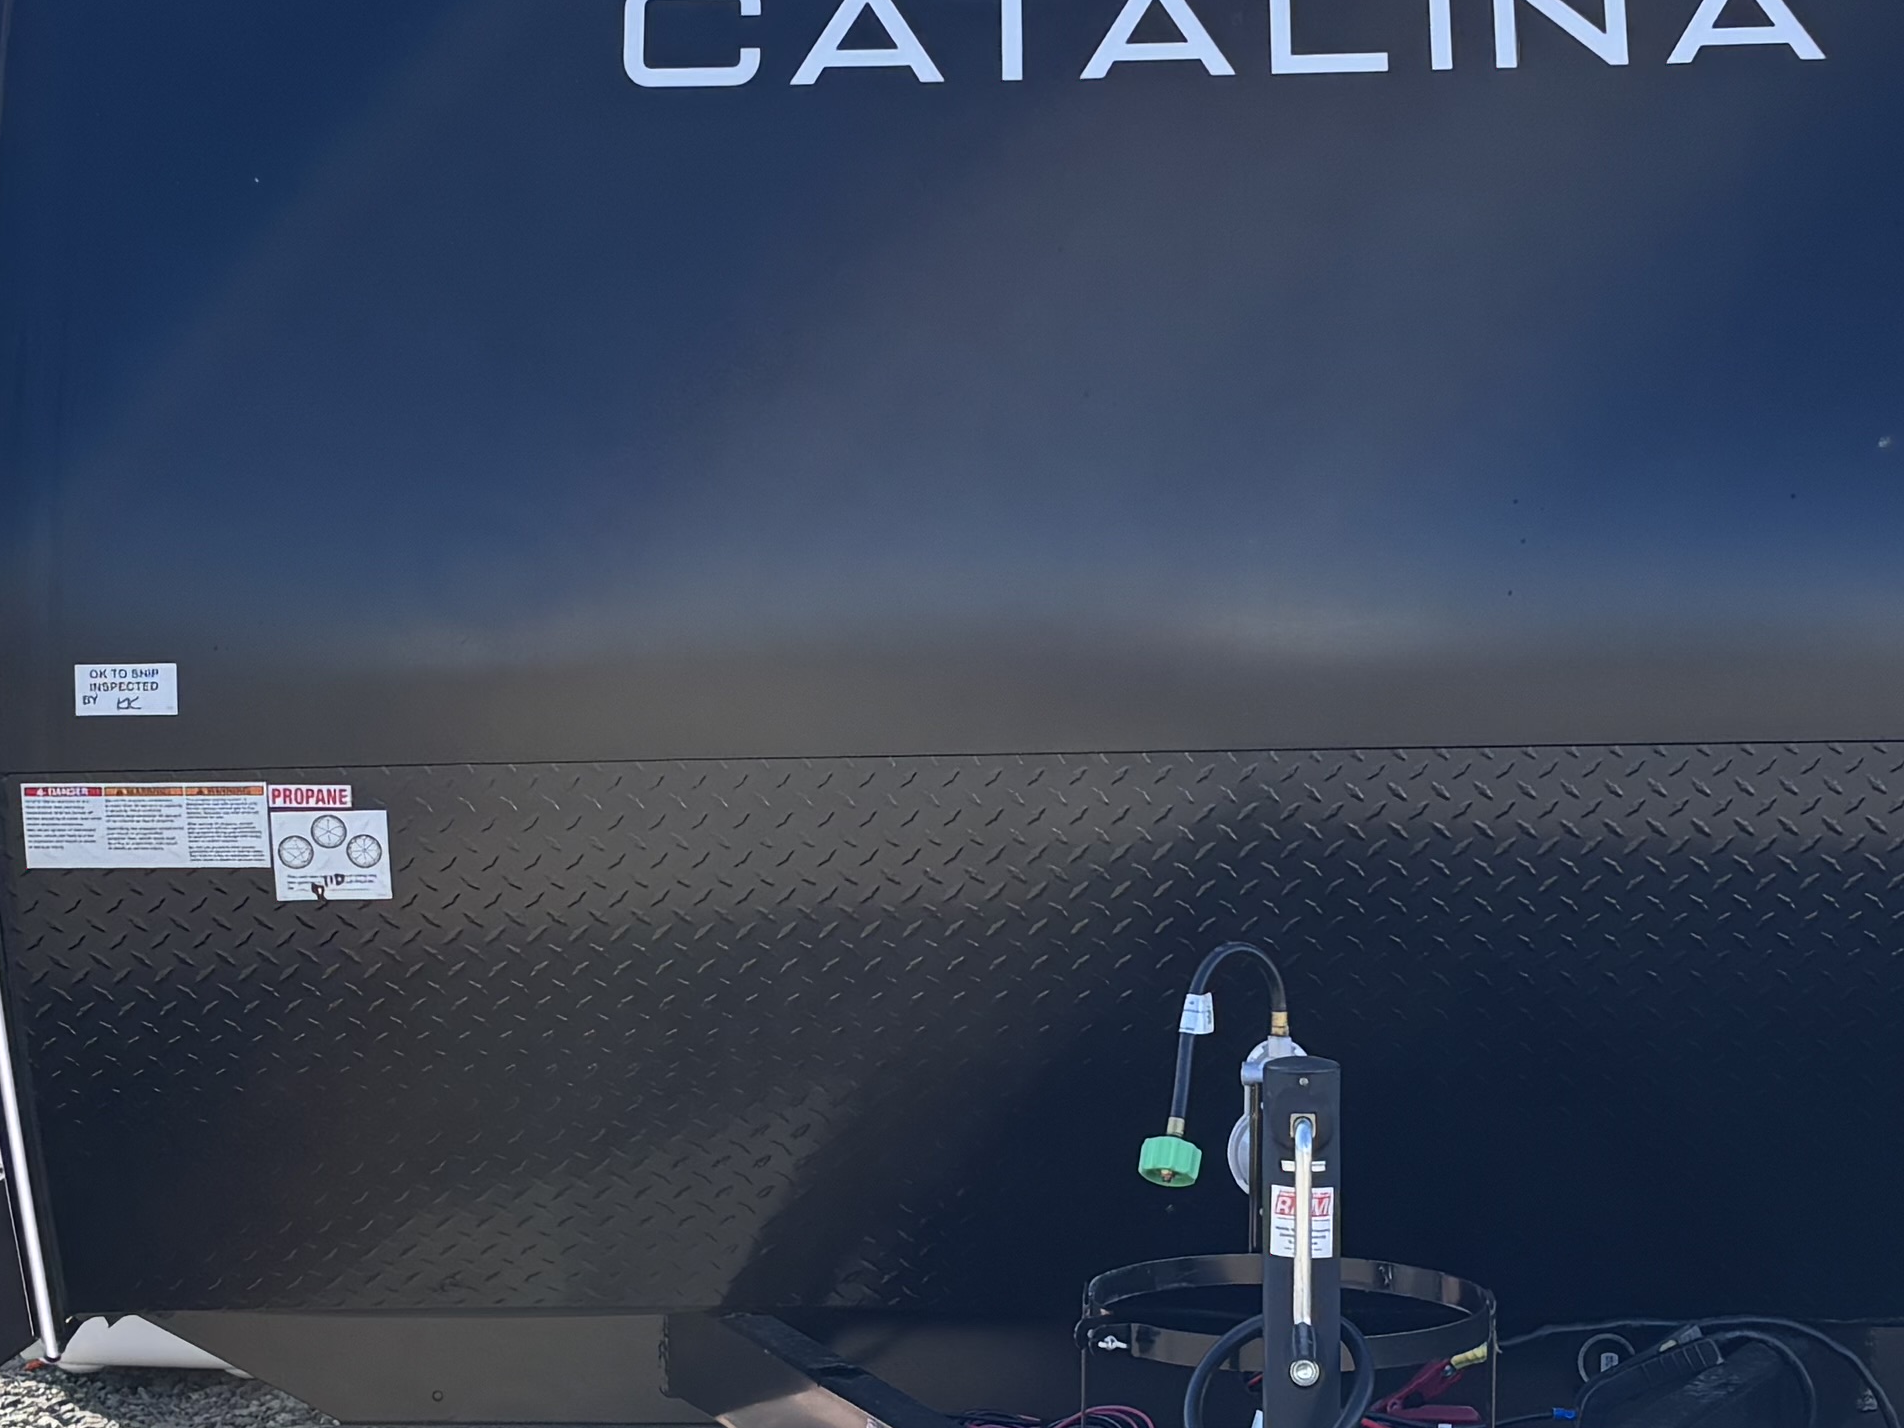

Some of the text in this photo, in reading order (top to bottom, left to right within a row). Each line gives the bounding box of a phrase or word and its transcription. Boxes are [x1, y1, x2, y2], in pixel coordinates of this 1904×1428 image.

[89, 668, 159, 679] OK TO SHIP
[90, 681, 159, 692] INSPECTED
[82, 694, 98, 705] BY
[48, 787, 89, 796] DANGER
[271, 788, 348, 805] PROPANE
[1276, 1196, 1330, 1216] RM
